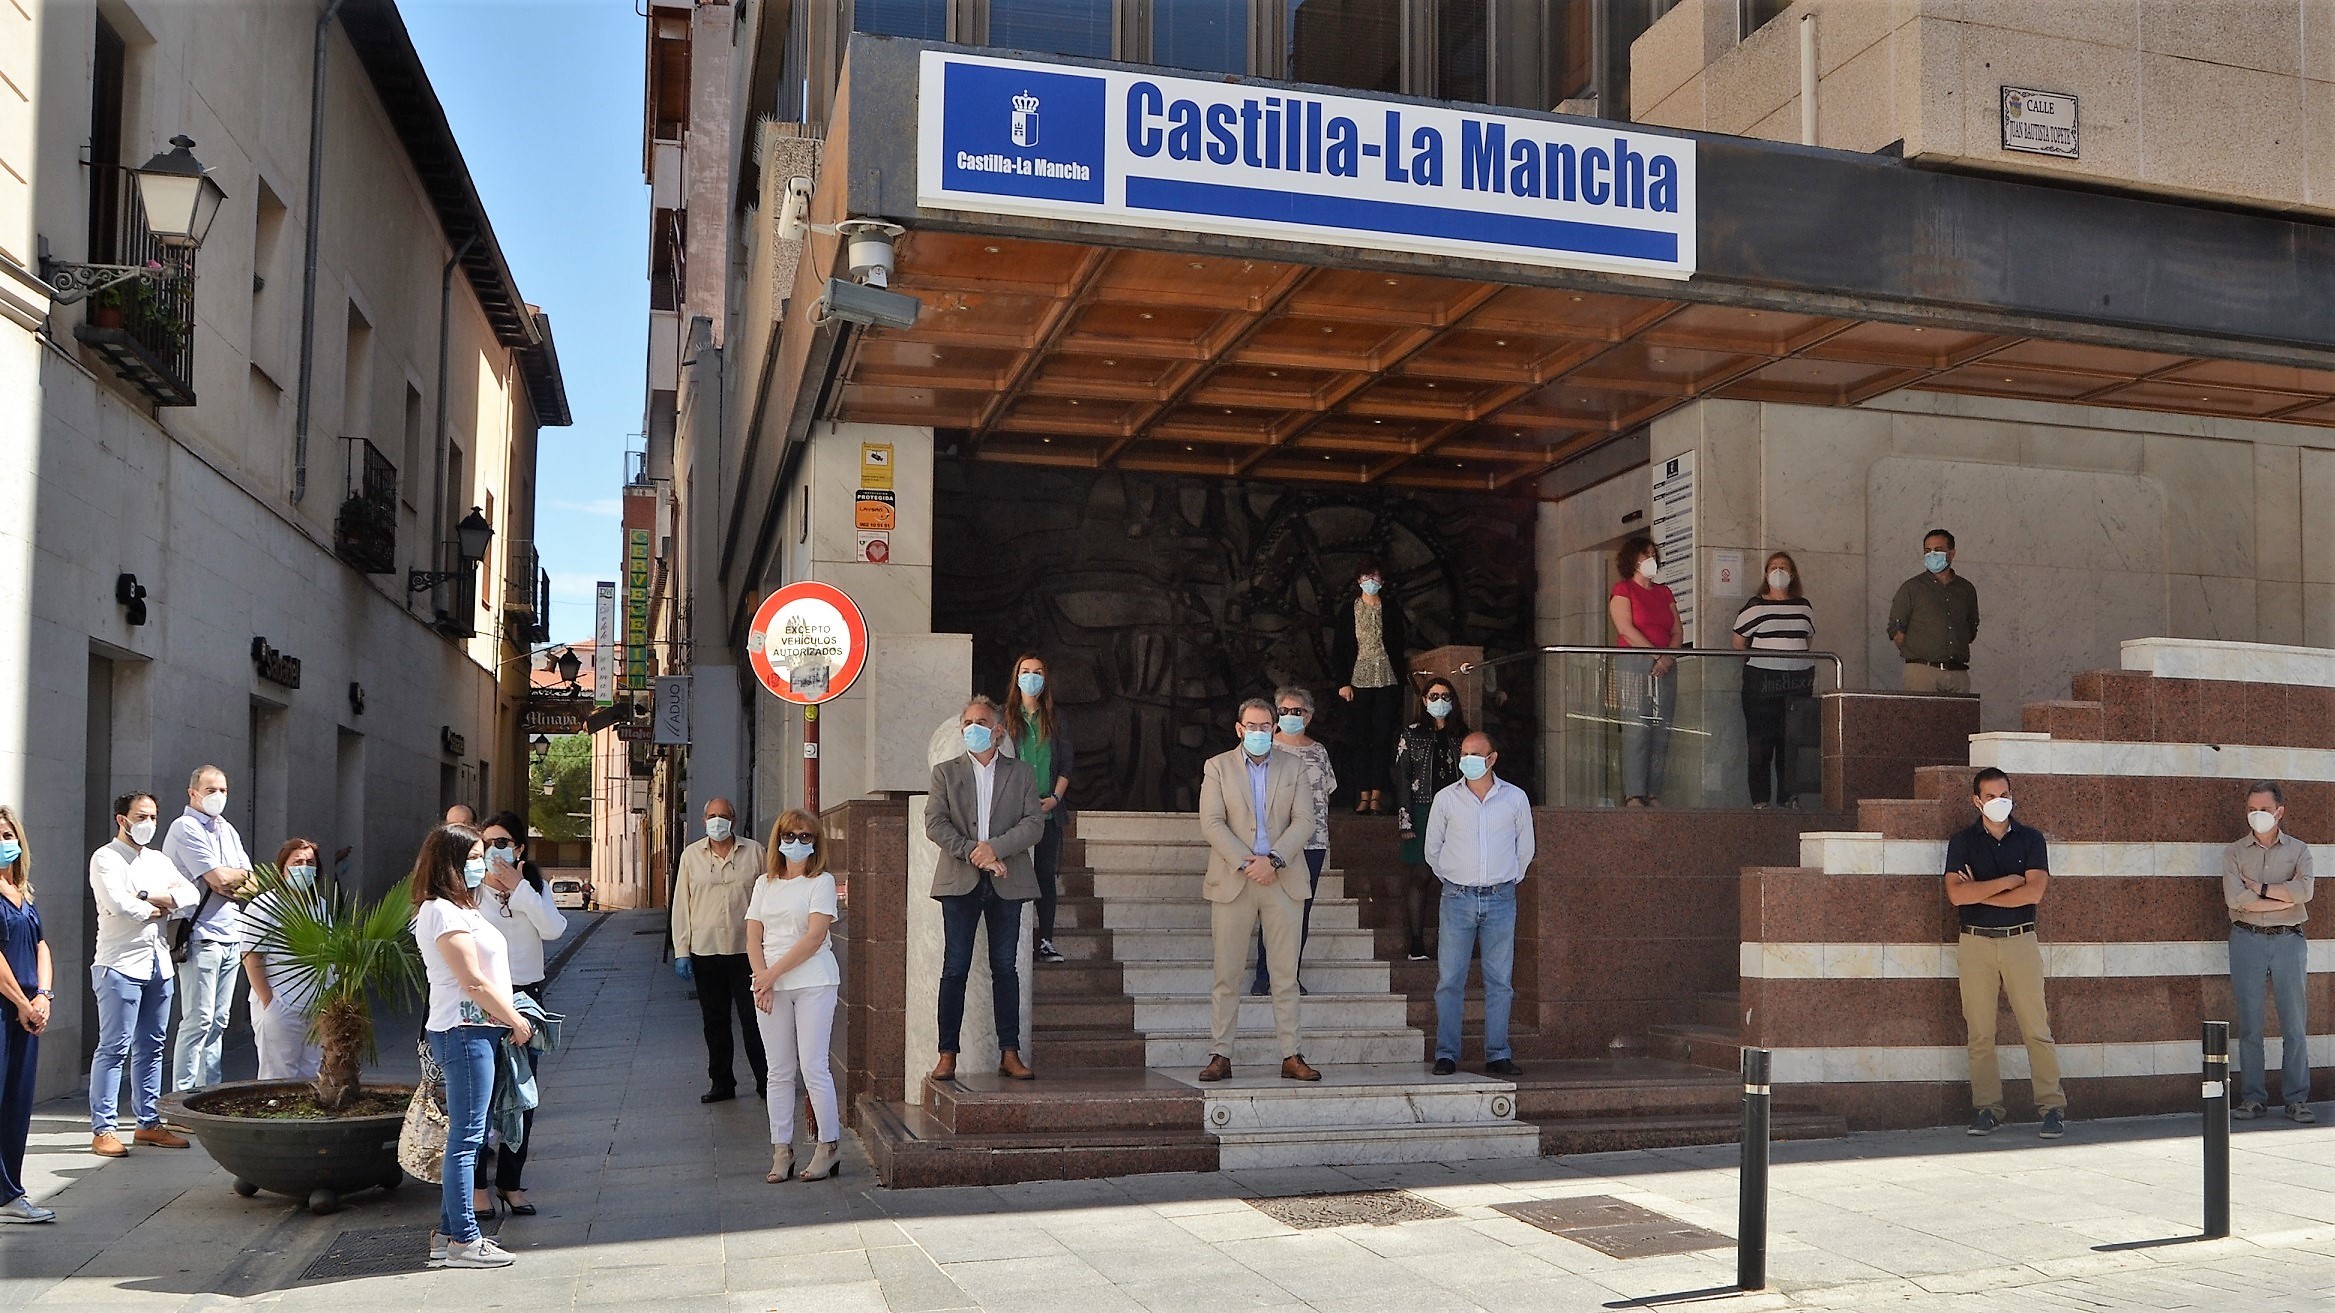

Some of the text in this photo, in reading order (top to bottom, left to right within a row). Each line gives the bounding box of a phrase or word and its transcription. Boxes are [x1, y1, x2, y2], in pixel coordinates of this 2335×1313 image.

[2026, 99, 2055, 115] CALLE
[2024, 122, 2050, 142] BAUTISTA
[2050, 126, 2071, 145] TOPETE
[1125, 80, 1679, 214] Castilla-La Mancha
[957, 151, 1090, 181] Castilla-La Mancha
[629, 530, 648, 675] CERVECERIA
[785, 625, 831, 634] EXCEPTO
[773, 647, 843, 657] AUTORIZADOS
